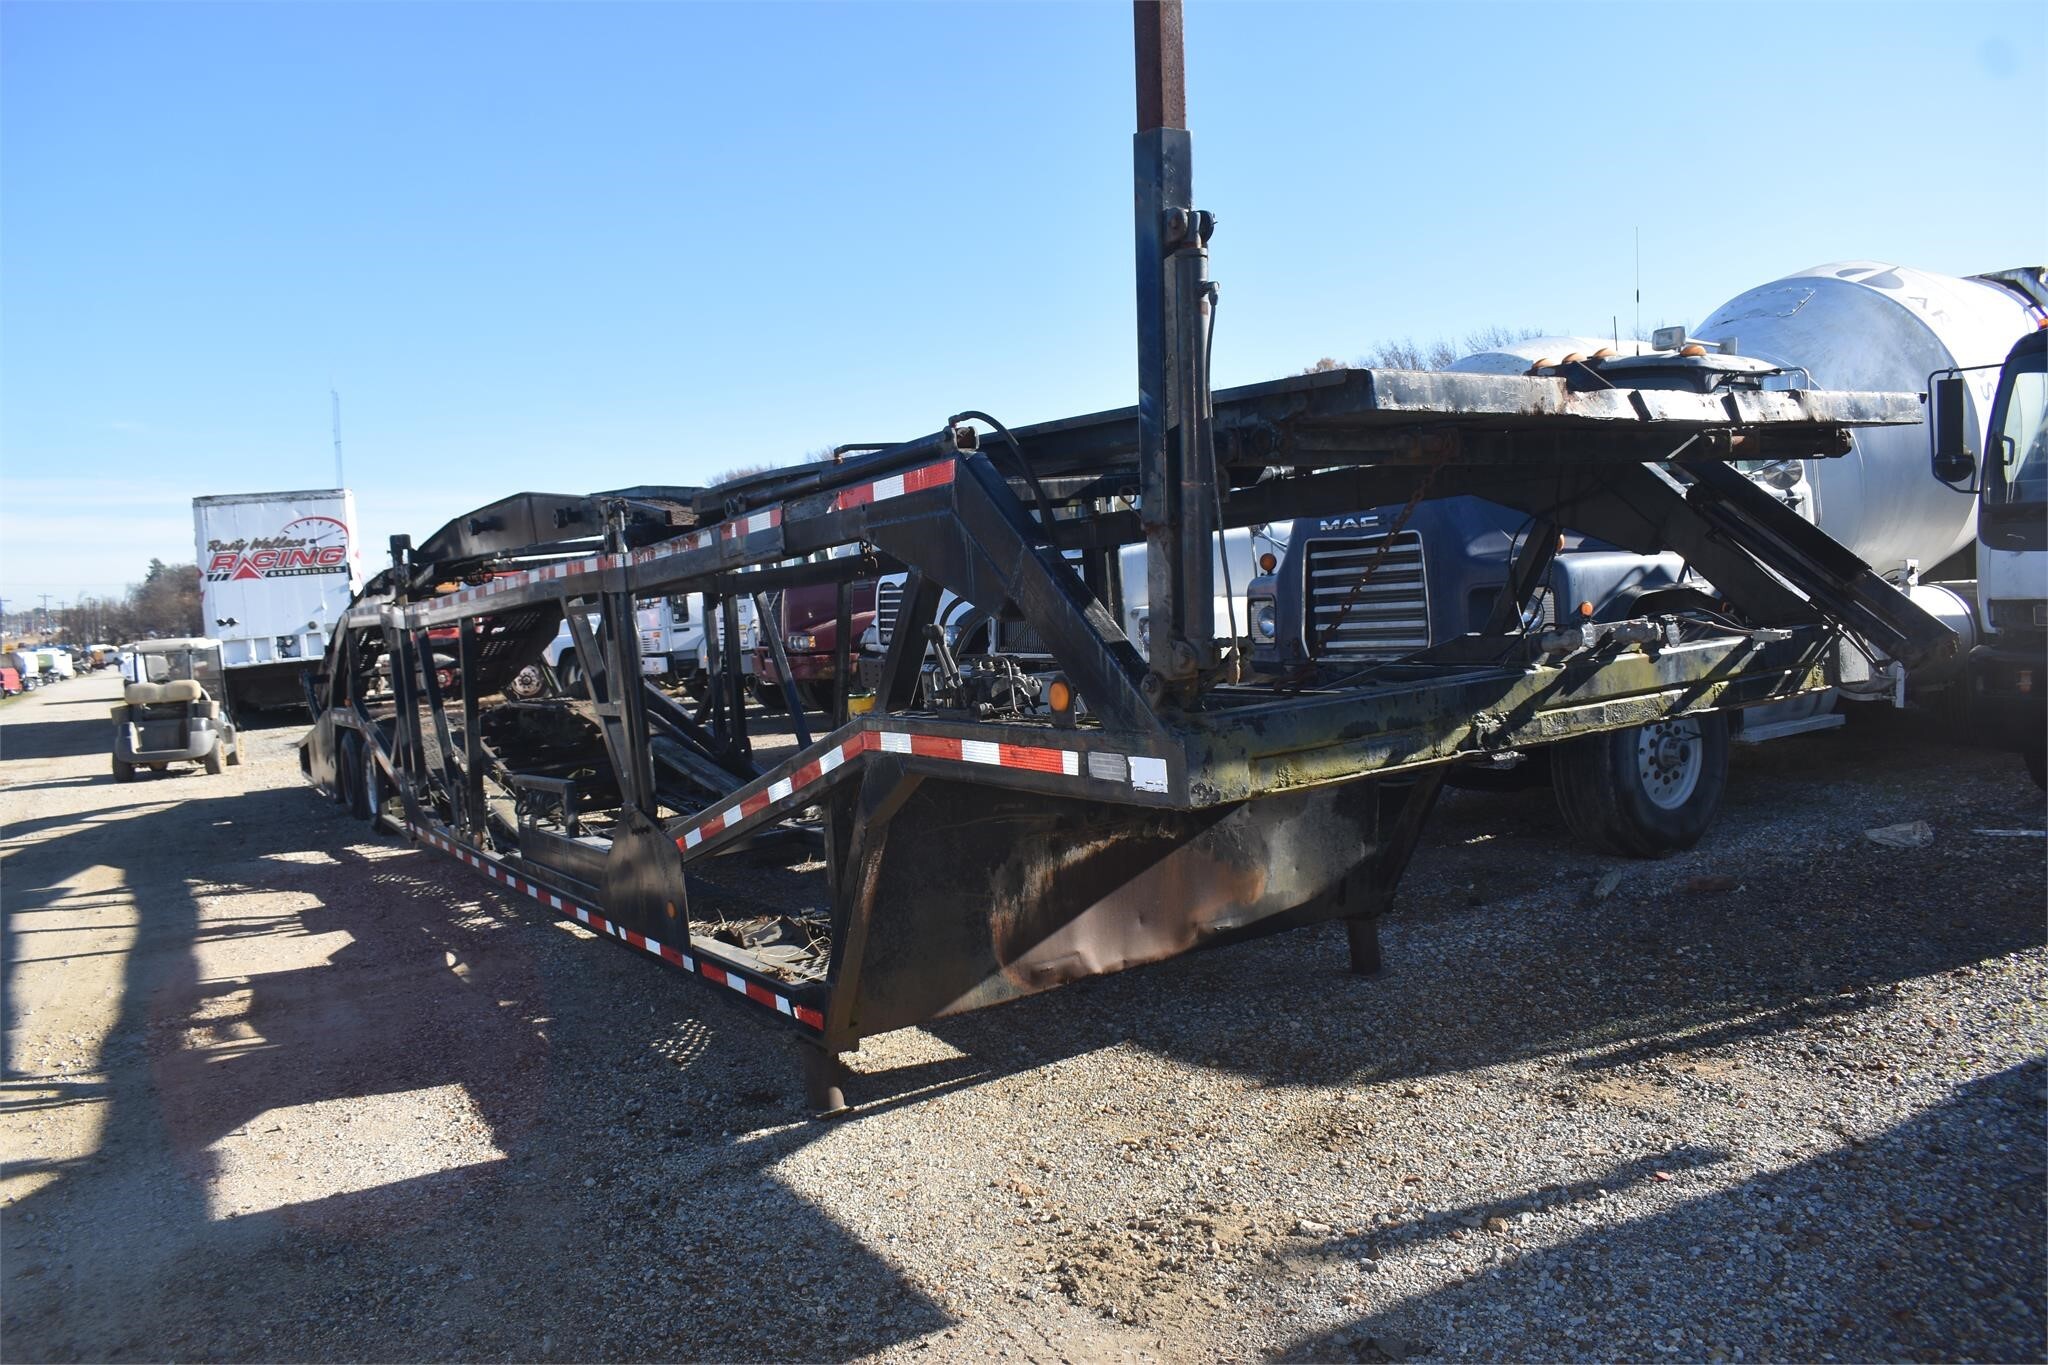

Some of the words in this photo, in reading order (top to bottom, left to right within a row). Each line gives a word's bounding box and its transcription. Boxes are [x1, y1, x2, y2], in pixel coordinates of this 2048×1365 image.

[208, 539, 248, 553] Rusty
[250, 536, 306, 550] Wallace
[210, 547, 346, 579] RACING
[270, 567, 342, 576] EXPERIENCE
